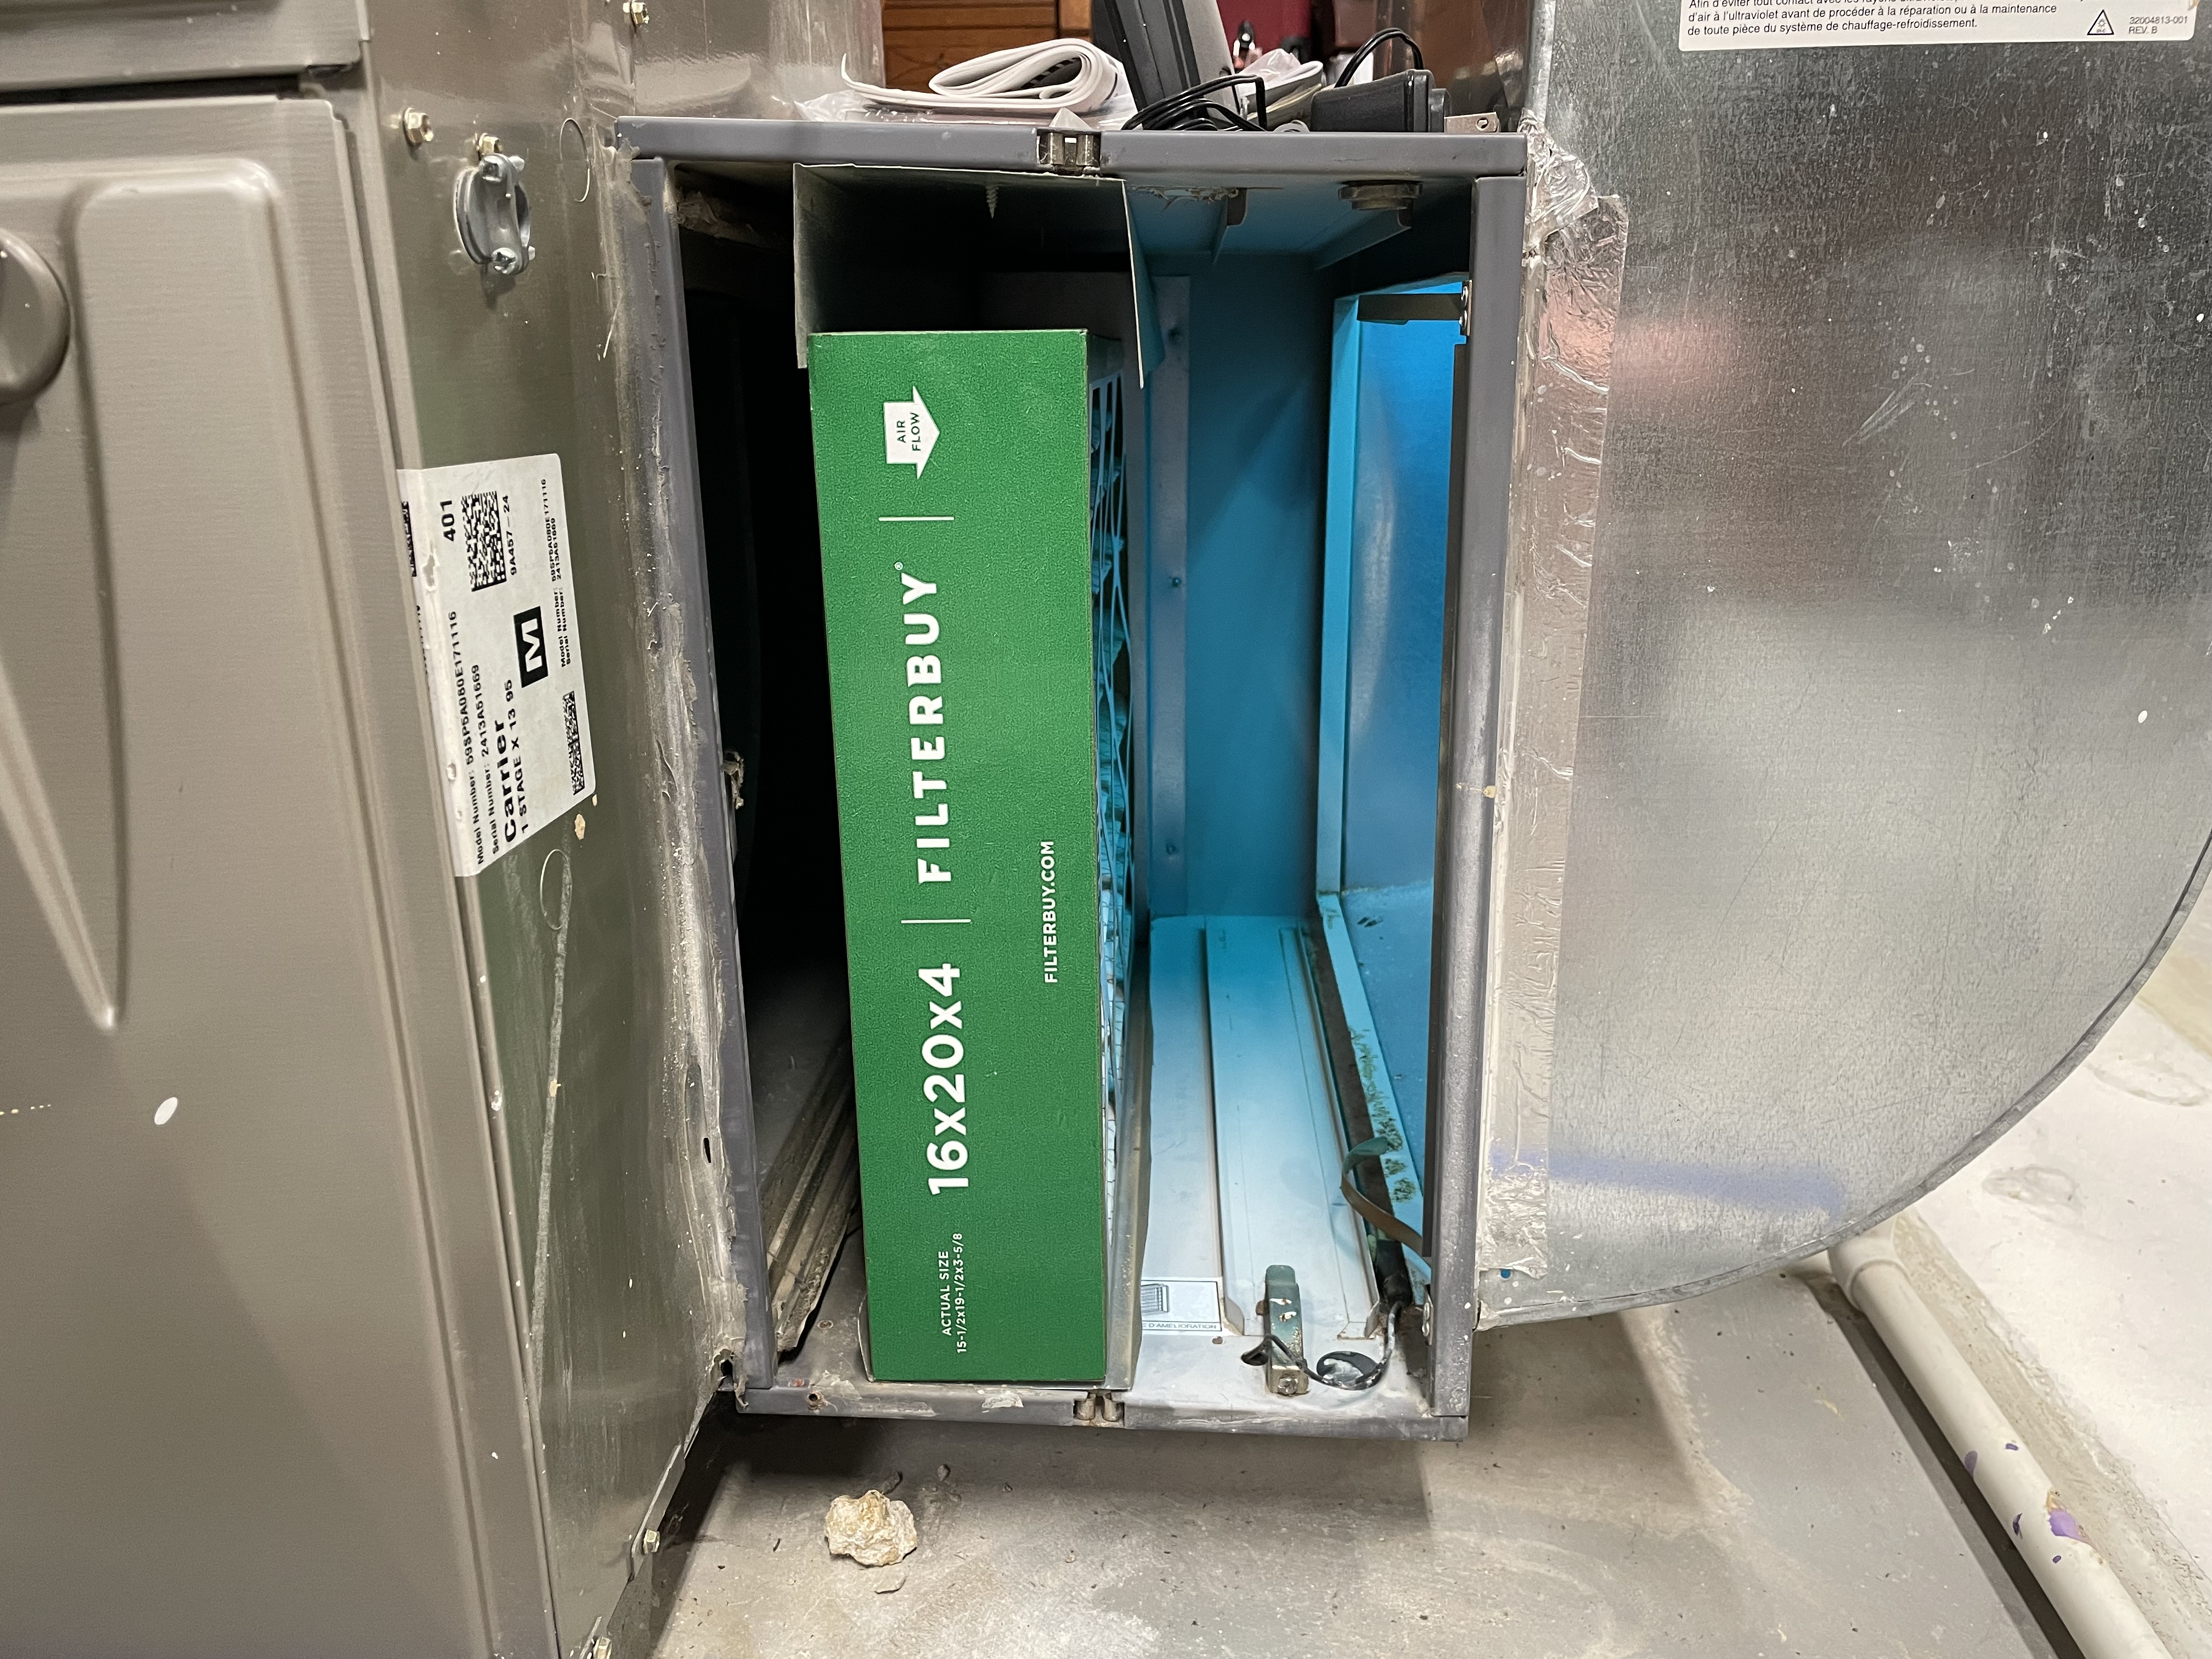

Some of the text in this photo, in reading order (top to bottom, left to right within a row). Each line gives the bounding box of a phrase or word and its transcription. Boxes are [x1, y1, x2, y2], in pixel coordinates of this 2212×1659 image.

[1688, 12, 1711, 21] d'air
[1713, 11, 1720, 21] à
[1723, 10, 1778, 21] l'ultraviolet
[1781, 9, 1810, 18] avant
[1813, 8, 1826, 18] de
[1829, 7, 1875, 19] procéder
[1877, 6, 1884, 16] à
[1887, 6, 1896, 15] la
[1899, 5, 1951, 17] réparation
[1970, 4, 1976, 14] à
[1979, 4, 1988, 13] la
[1991, 3, 2057, 13] maintenance
[1688, 18, 1977, 36] de toute pièce du système de chauffage-refroidissement.
[2128, 26, 2158, 34] REV. B
[2129, 16, 2188, 25] 32004813-001
[896, 420, 906, 443] AIR
[910, 411, 921, 452] FLOW
[439, 500, 456, 541] 401
[503, 494, 510, 513] 24
[506, 531, 517, 575] 9A457
[553, 587, 562, 632] Number:
[558, 587, 567, 631] Number:
[521, 618, 543, 673] M
[558, 636, 566, 668] Model
[448, 611, 484, 865] Model Number: 59SP5A080E171116
[471, 664, 499, 854] Serial Number: 2413A51669
[504, 679, 529, 833] 1 STAGE X 13 95
[494, 720, 516, 843] Carrier
[1040, 841, 1058, 984] FILTERBUY.COM
[918, 963, 969, 1195] 16x20x4
[938, 1251, 952, 1336] ACTUAL SIZE
[952, 1233, 967, 1353] 15-1/2x19-1/2x3-5/8
